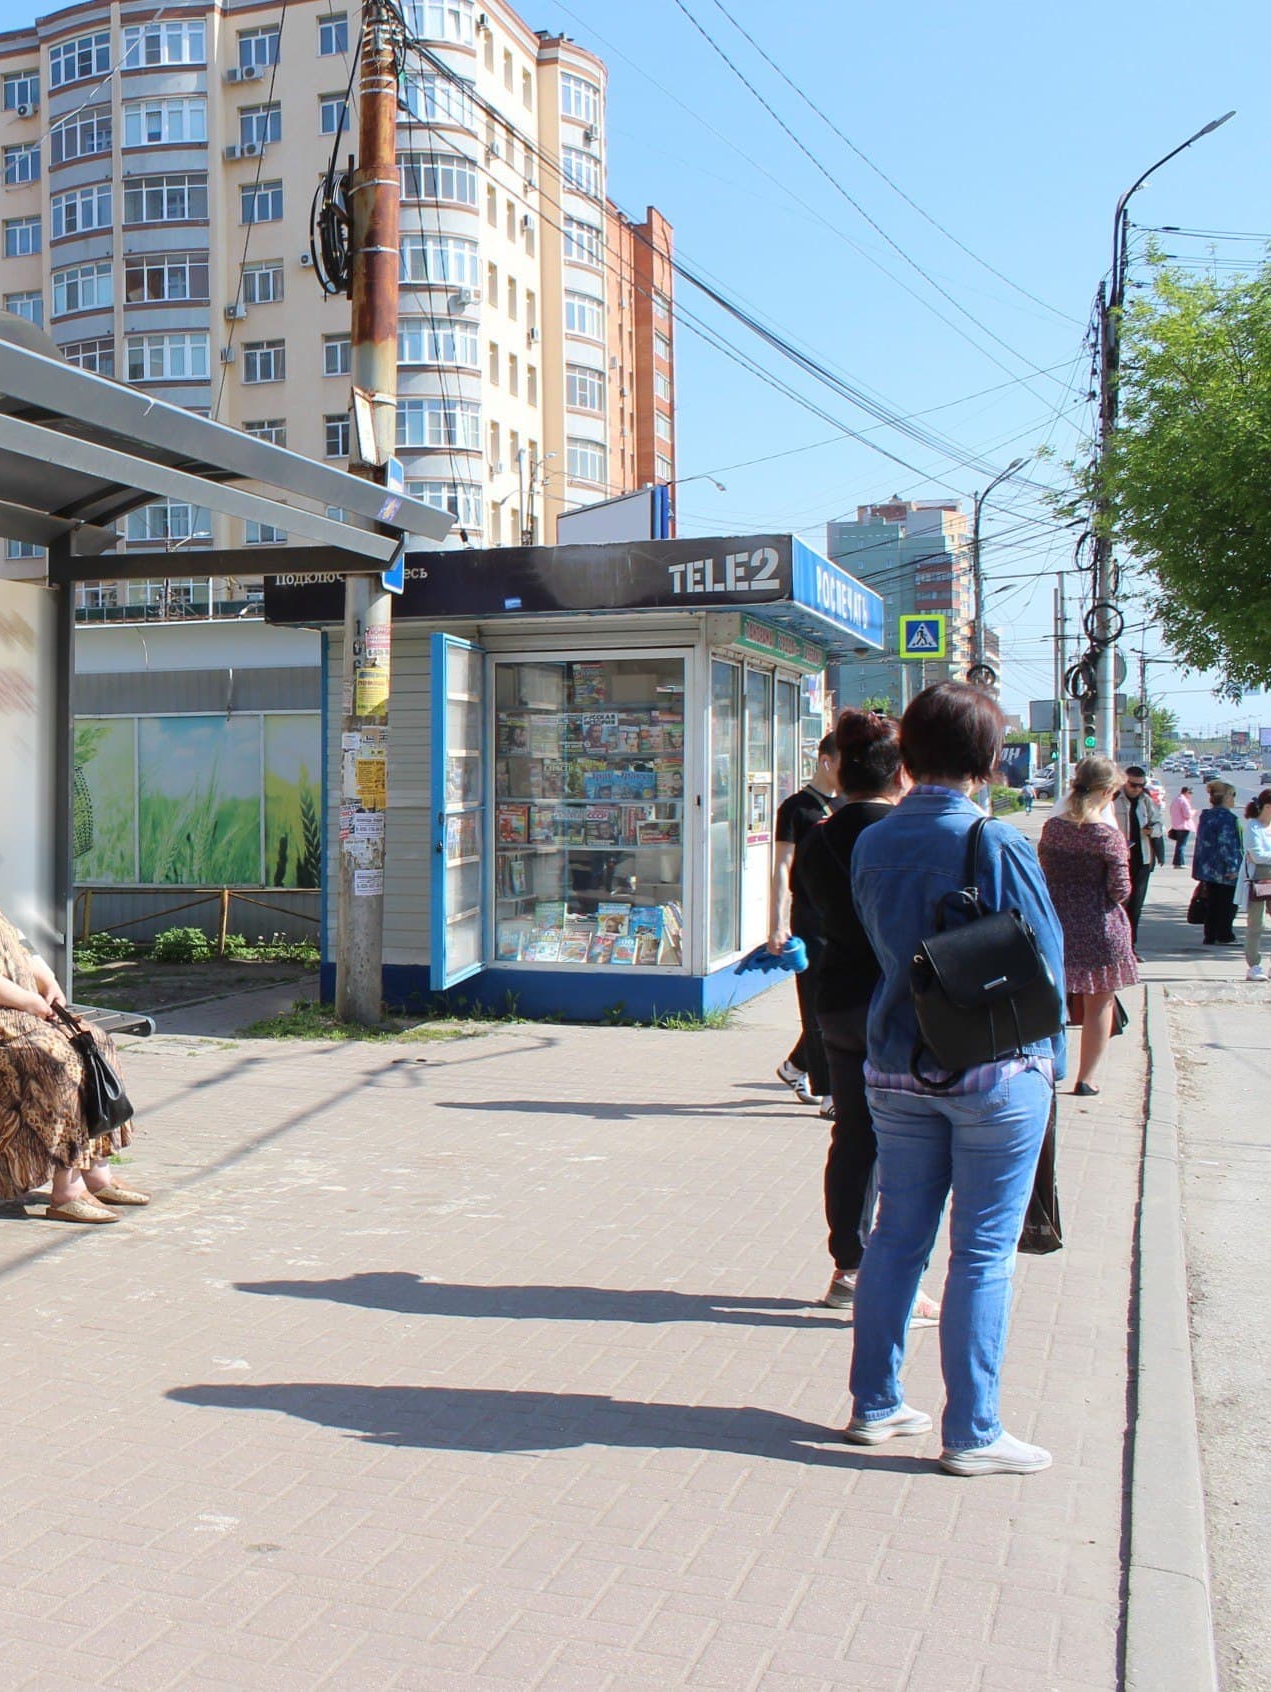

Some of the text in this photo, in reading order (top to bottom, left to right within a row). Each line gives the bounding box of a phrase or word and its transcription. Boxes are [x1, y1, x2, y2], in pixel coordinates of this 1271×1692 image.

[275, 568, 428, 587] Подключ есь
[668, 547, 780, 594] TELE2
[816, 565, 868, 630] РОСПЕЧАТЬ
